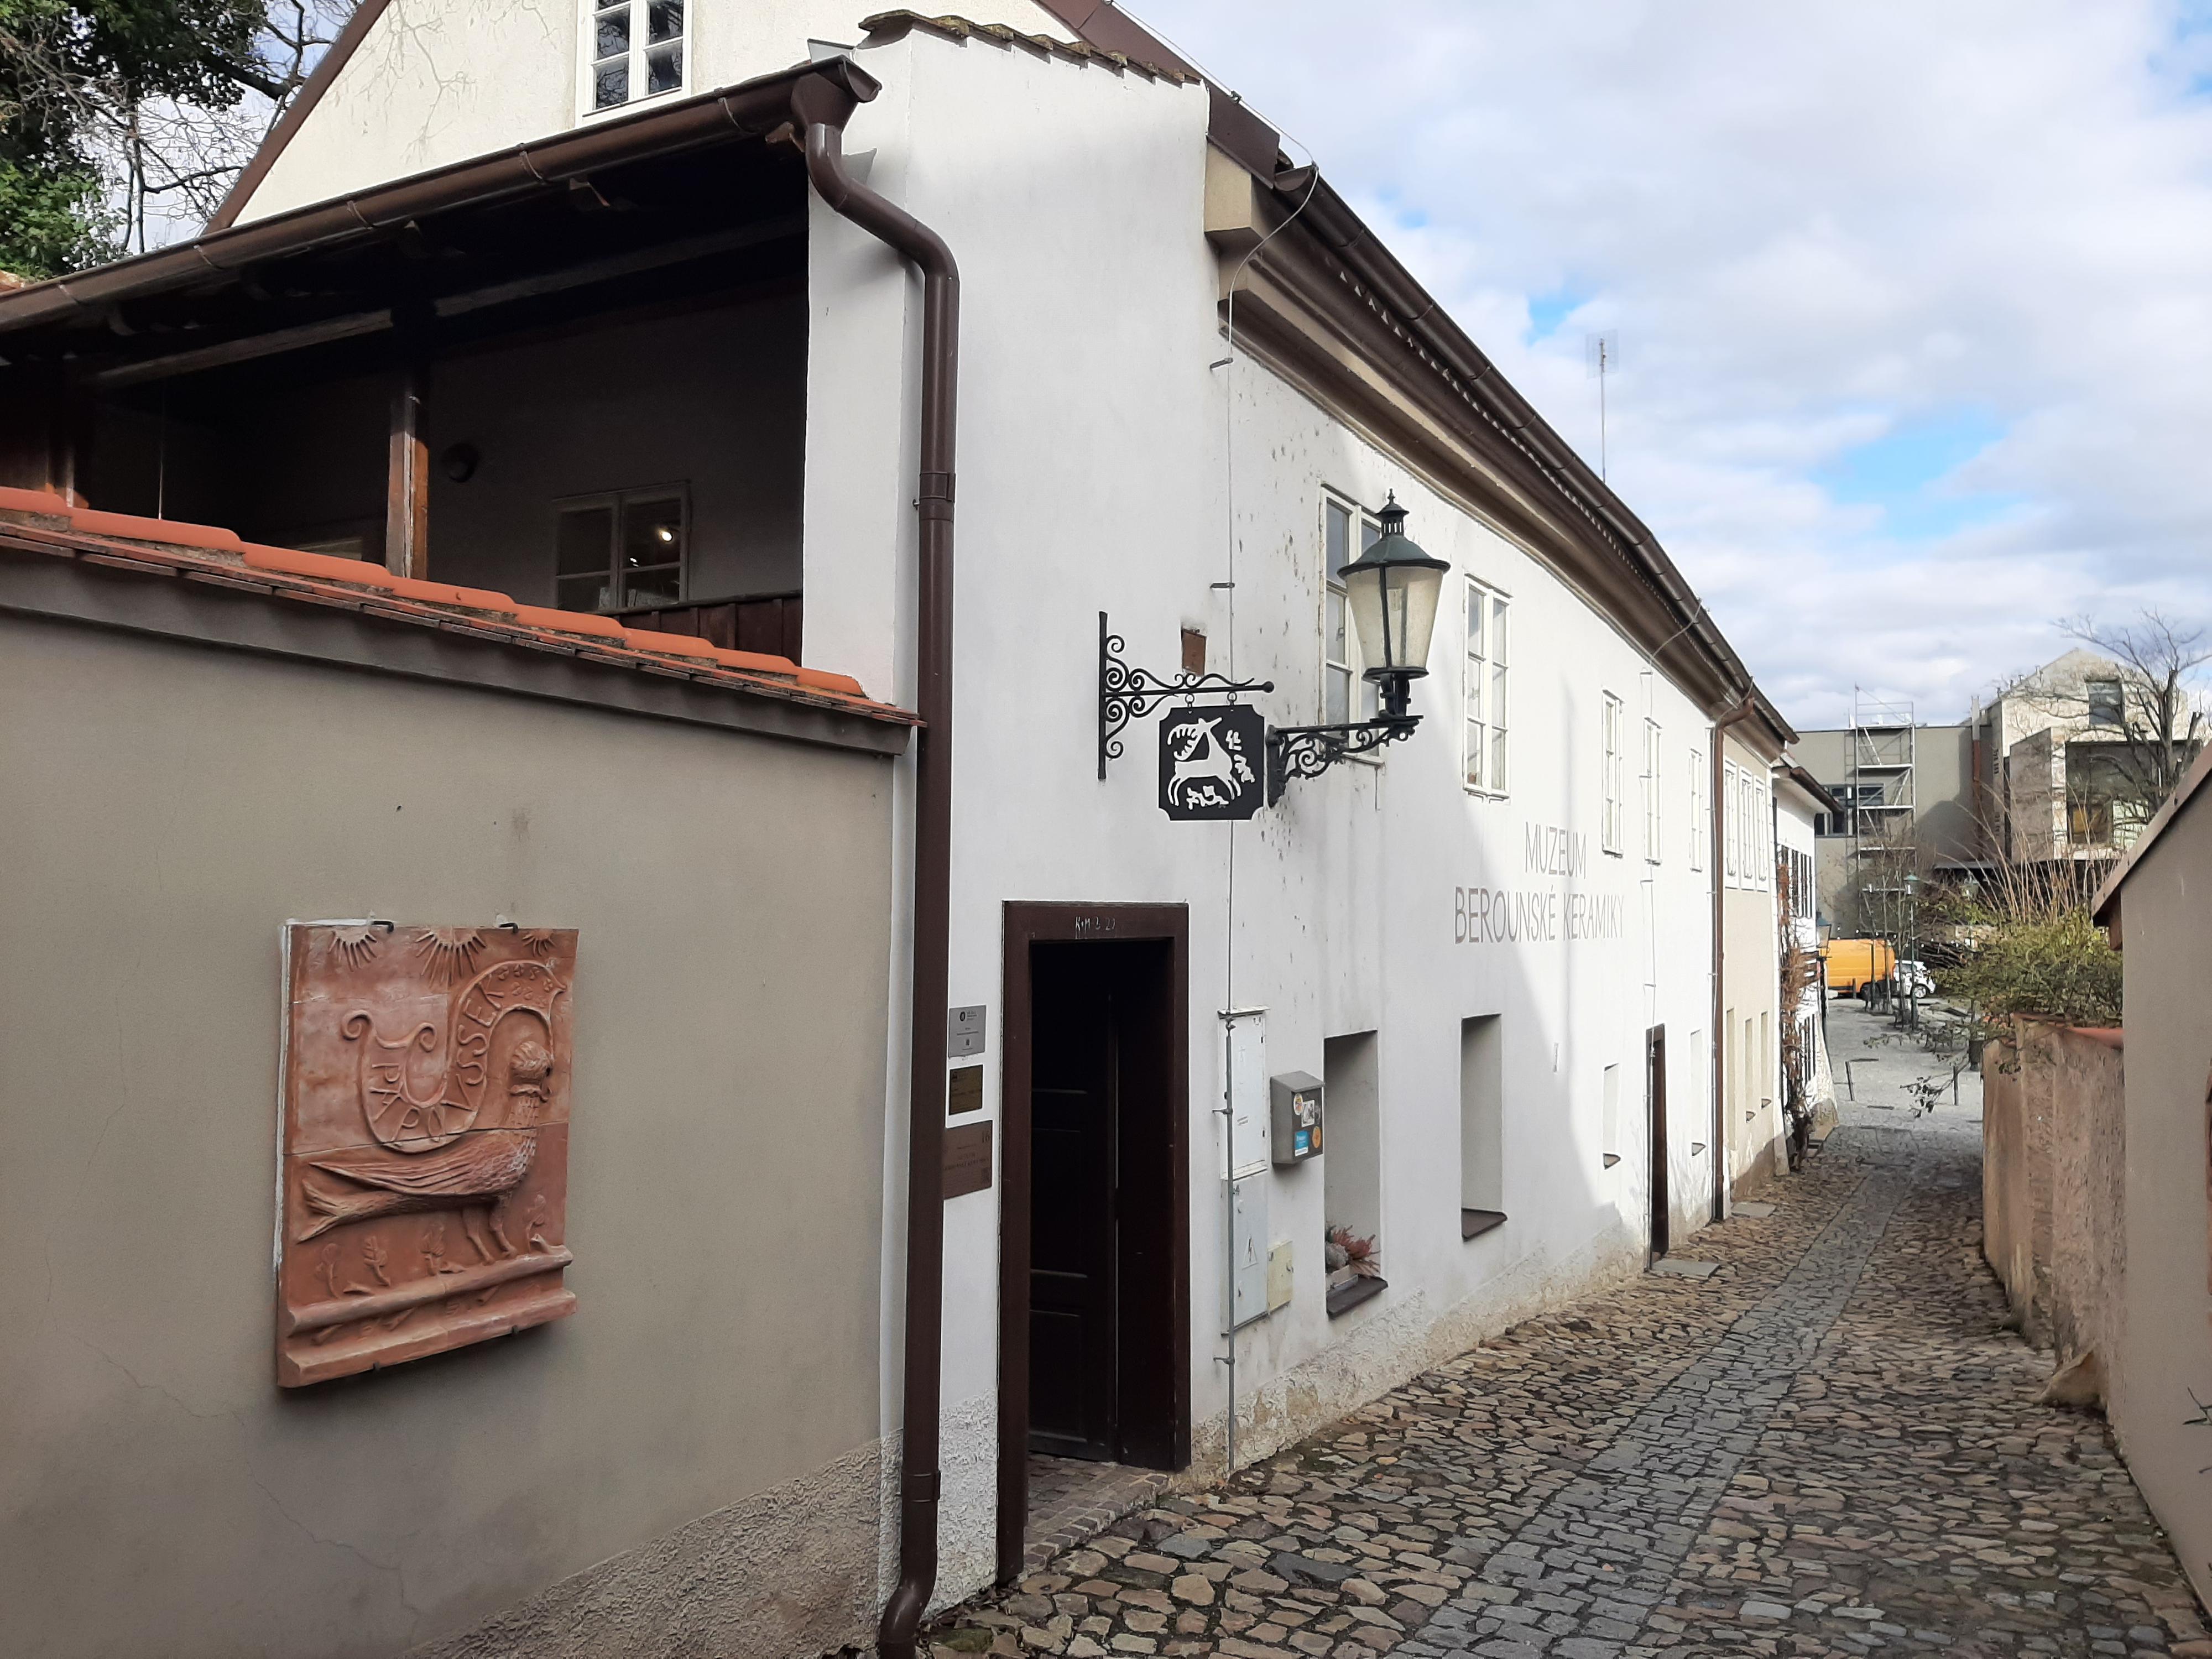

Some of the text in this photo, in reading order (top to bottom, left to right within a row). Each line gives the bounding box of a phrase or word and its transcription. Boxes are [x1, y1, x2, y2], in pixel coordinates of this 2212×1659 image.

[1525, 821, 1586, 879] MUZEUM
[1455, 884, 1624, 944] BEROUNSKÉ KERAMIKY
